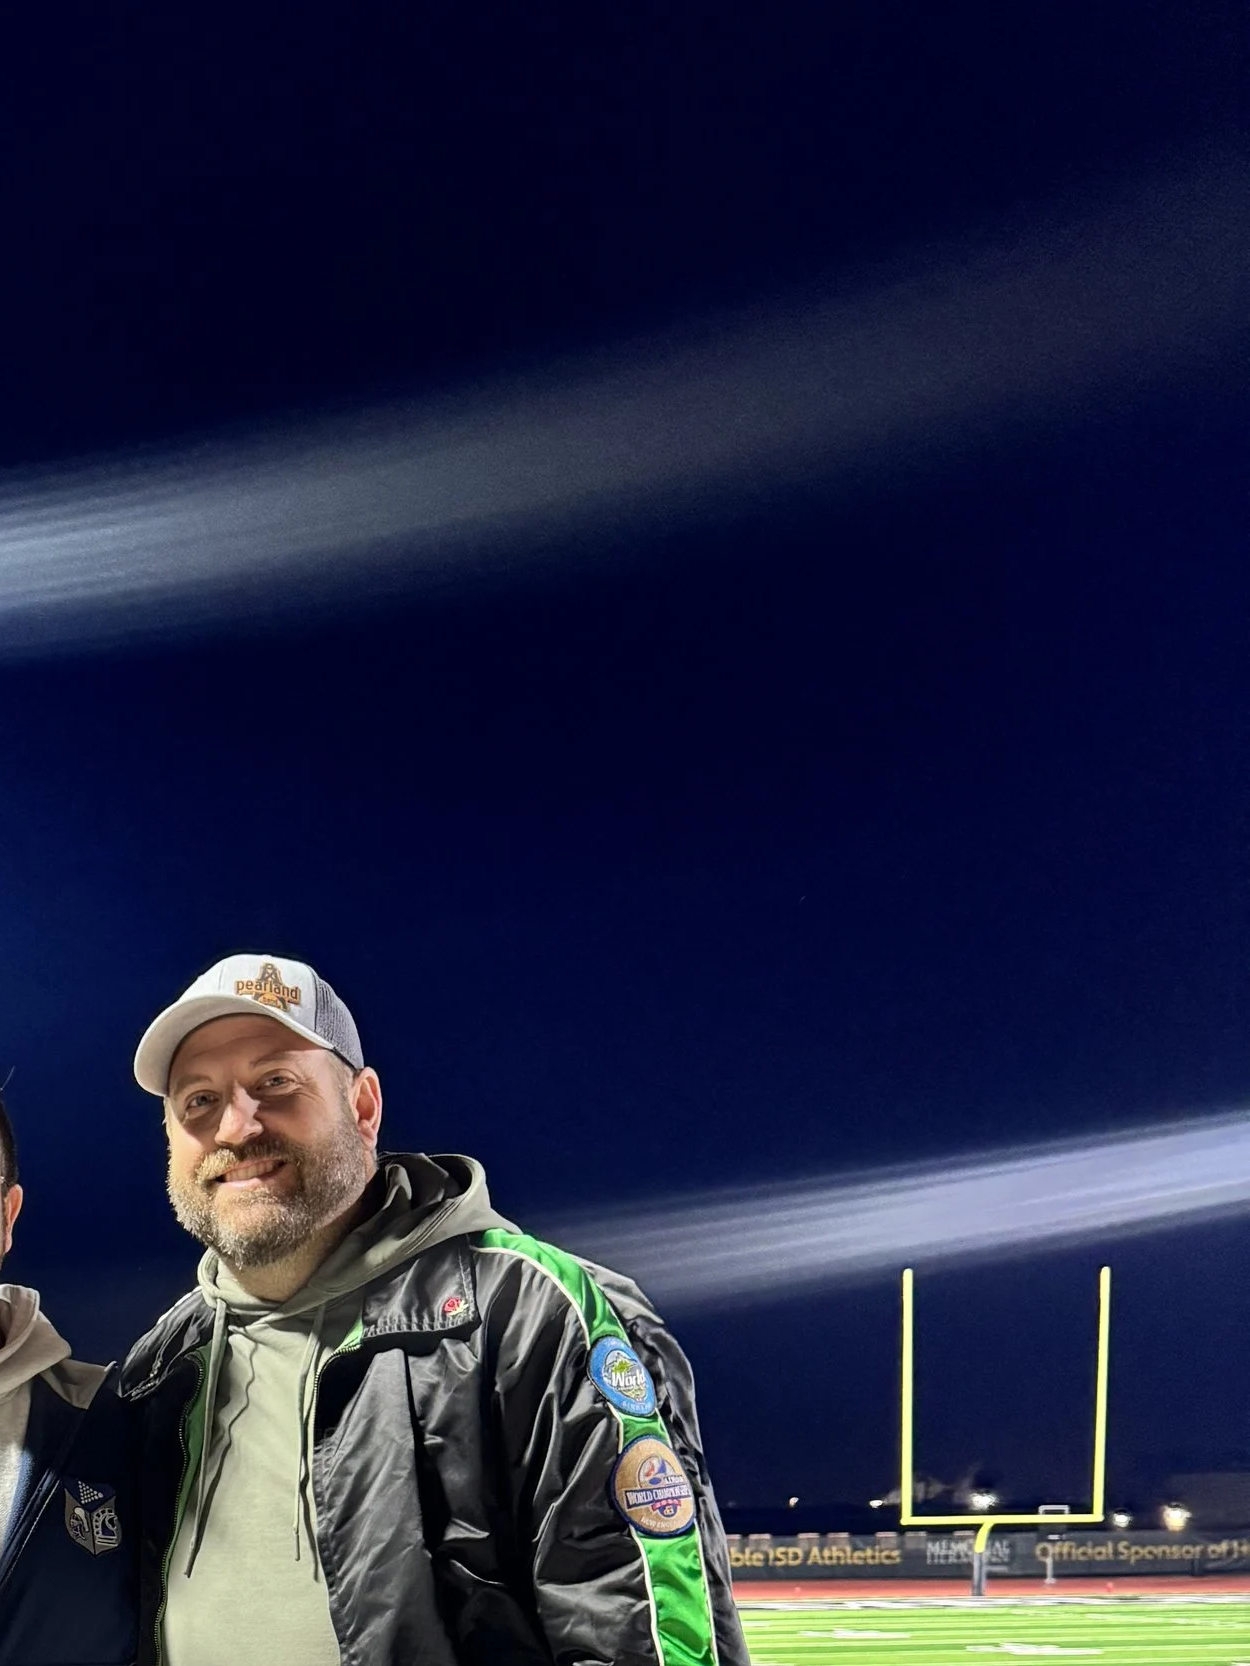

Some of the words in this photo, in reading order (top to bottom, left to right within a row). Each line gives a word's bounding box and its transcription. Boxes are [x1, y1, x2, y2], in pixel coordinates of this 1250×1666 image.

[237, 980, 299, 1000] pearland
[730, 1548, 763, 1567] ble
[768, 1547, 802, 1566] ISD
[807, 1545, 902, 1566] Athletics
[1036, 1541, 1114, 1562] Official
[1117, 1540, 1201, 1565] Sponsor
